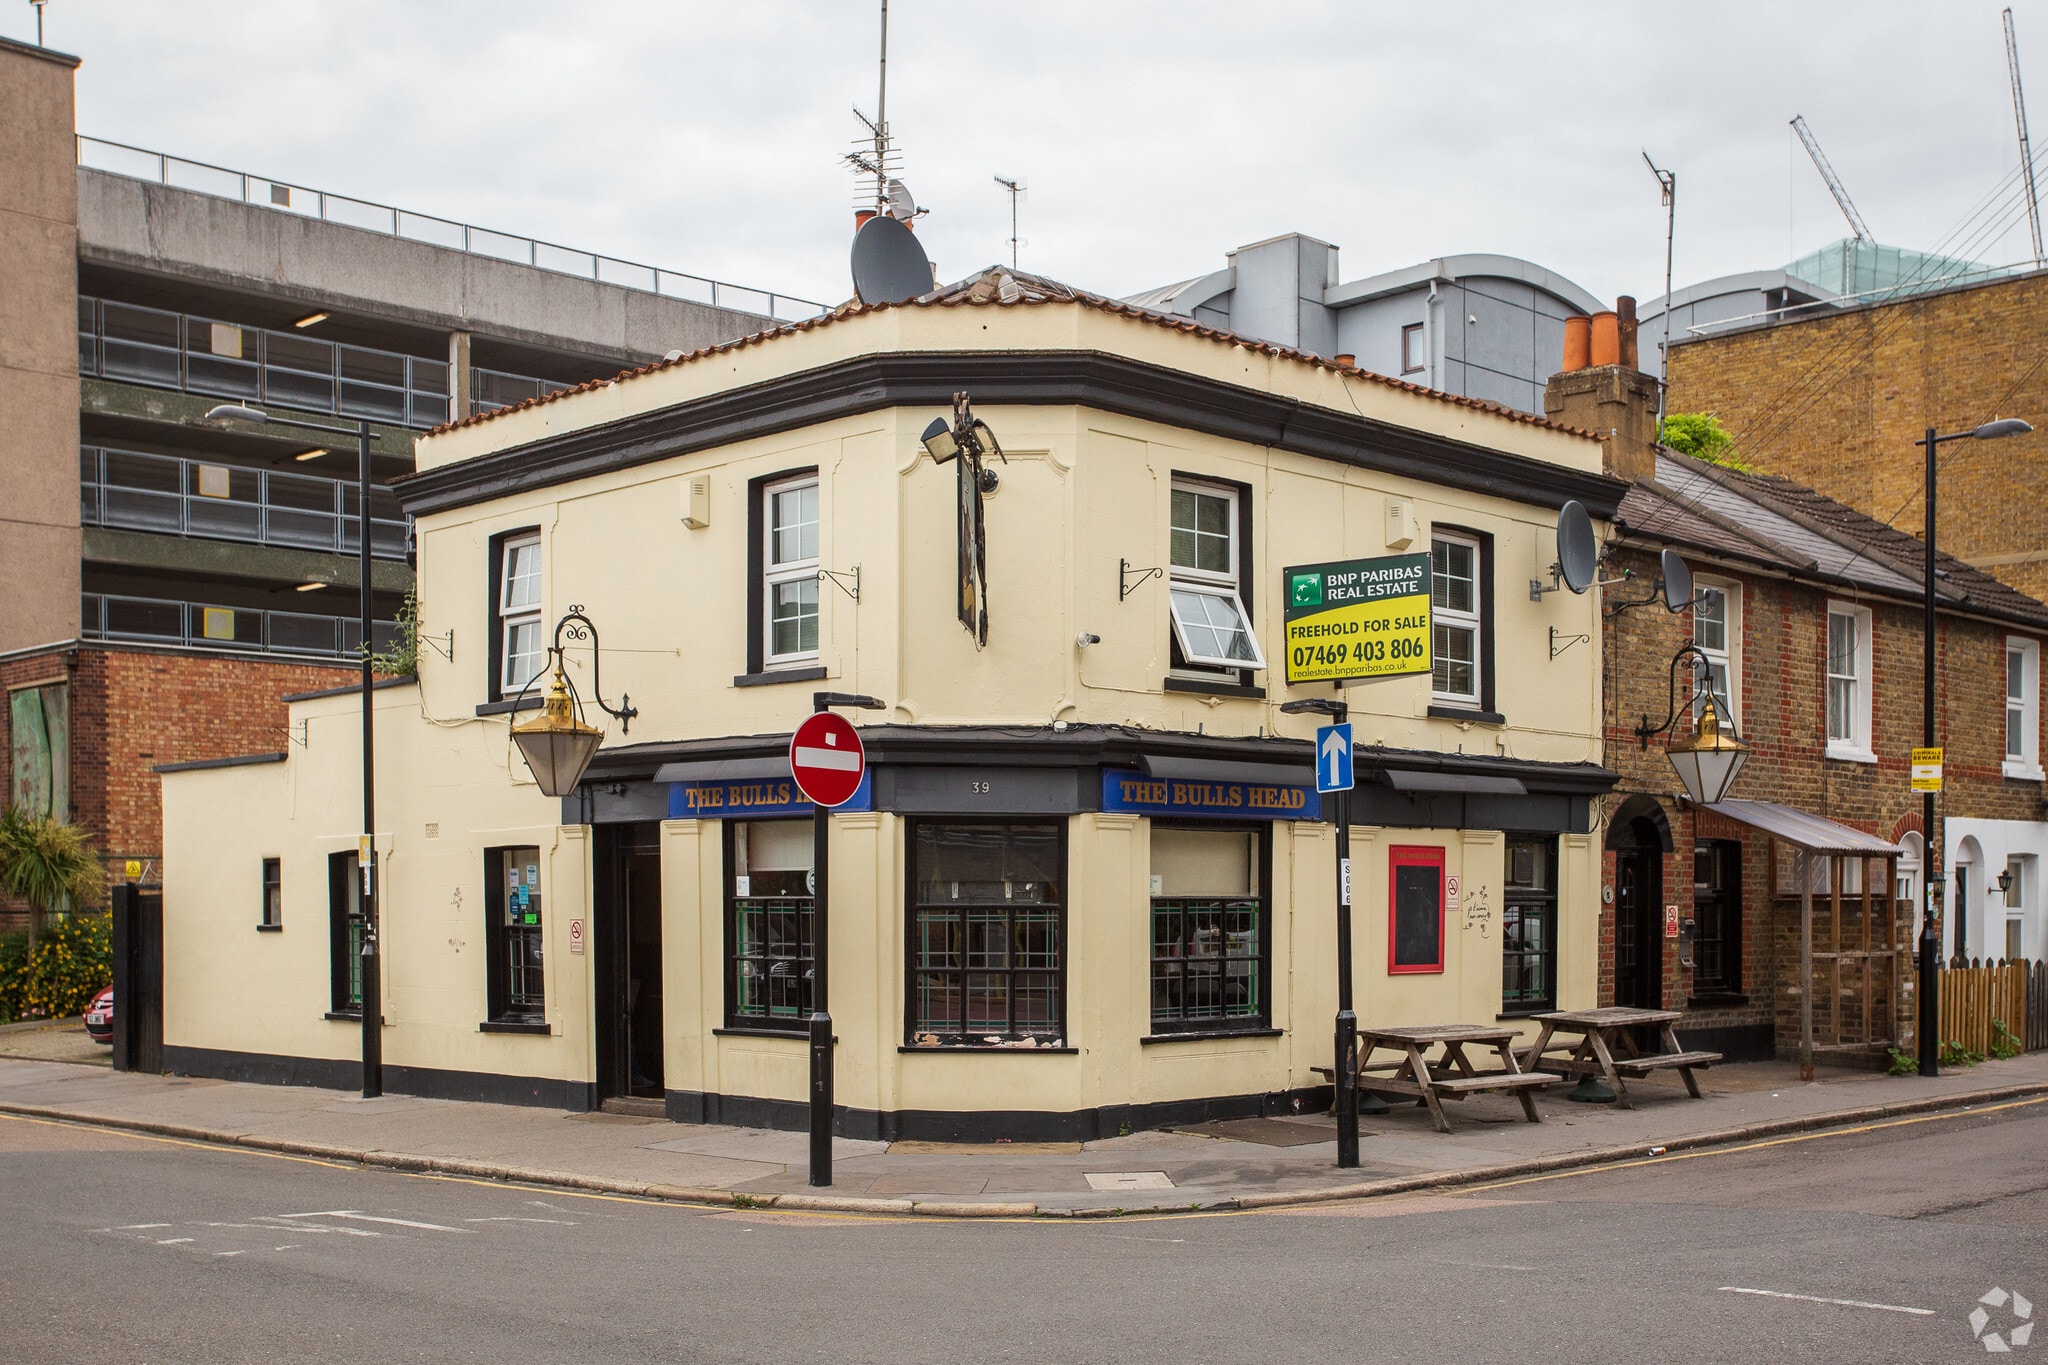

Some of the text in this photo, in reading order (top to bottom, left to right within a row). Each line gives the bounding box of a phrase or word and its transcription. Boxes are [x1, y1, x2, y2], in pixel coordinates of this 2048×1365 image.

[1327, 565, 1423, 587] BNP PARIBAS
[1328, 580, 1418, 600] REAL ESTATE
[1291, 615, 1426, 639] FREEHOLD FOR SALE
[1293, 636, 1423, 667] 07469 403 806
[1293, 660, 1407, 678] realestate.bnpparibas.co.uk
[685, 787, 723, 808] THE
[728, 783, 790, 807] BULLS
[972, 781, 990, 794] 39
[1120, 780, 1305, 809] THE BULLS HEAD
